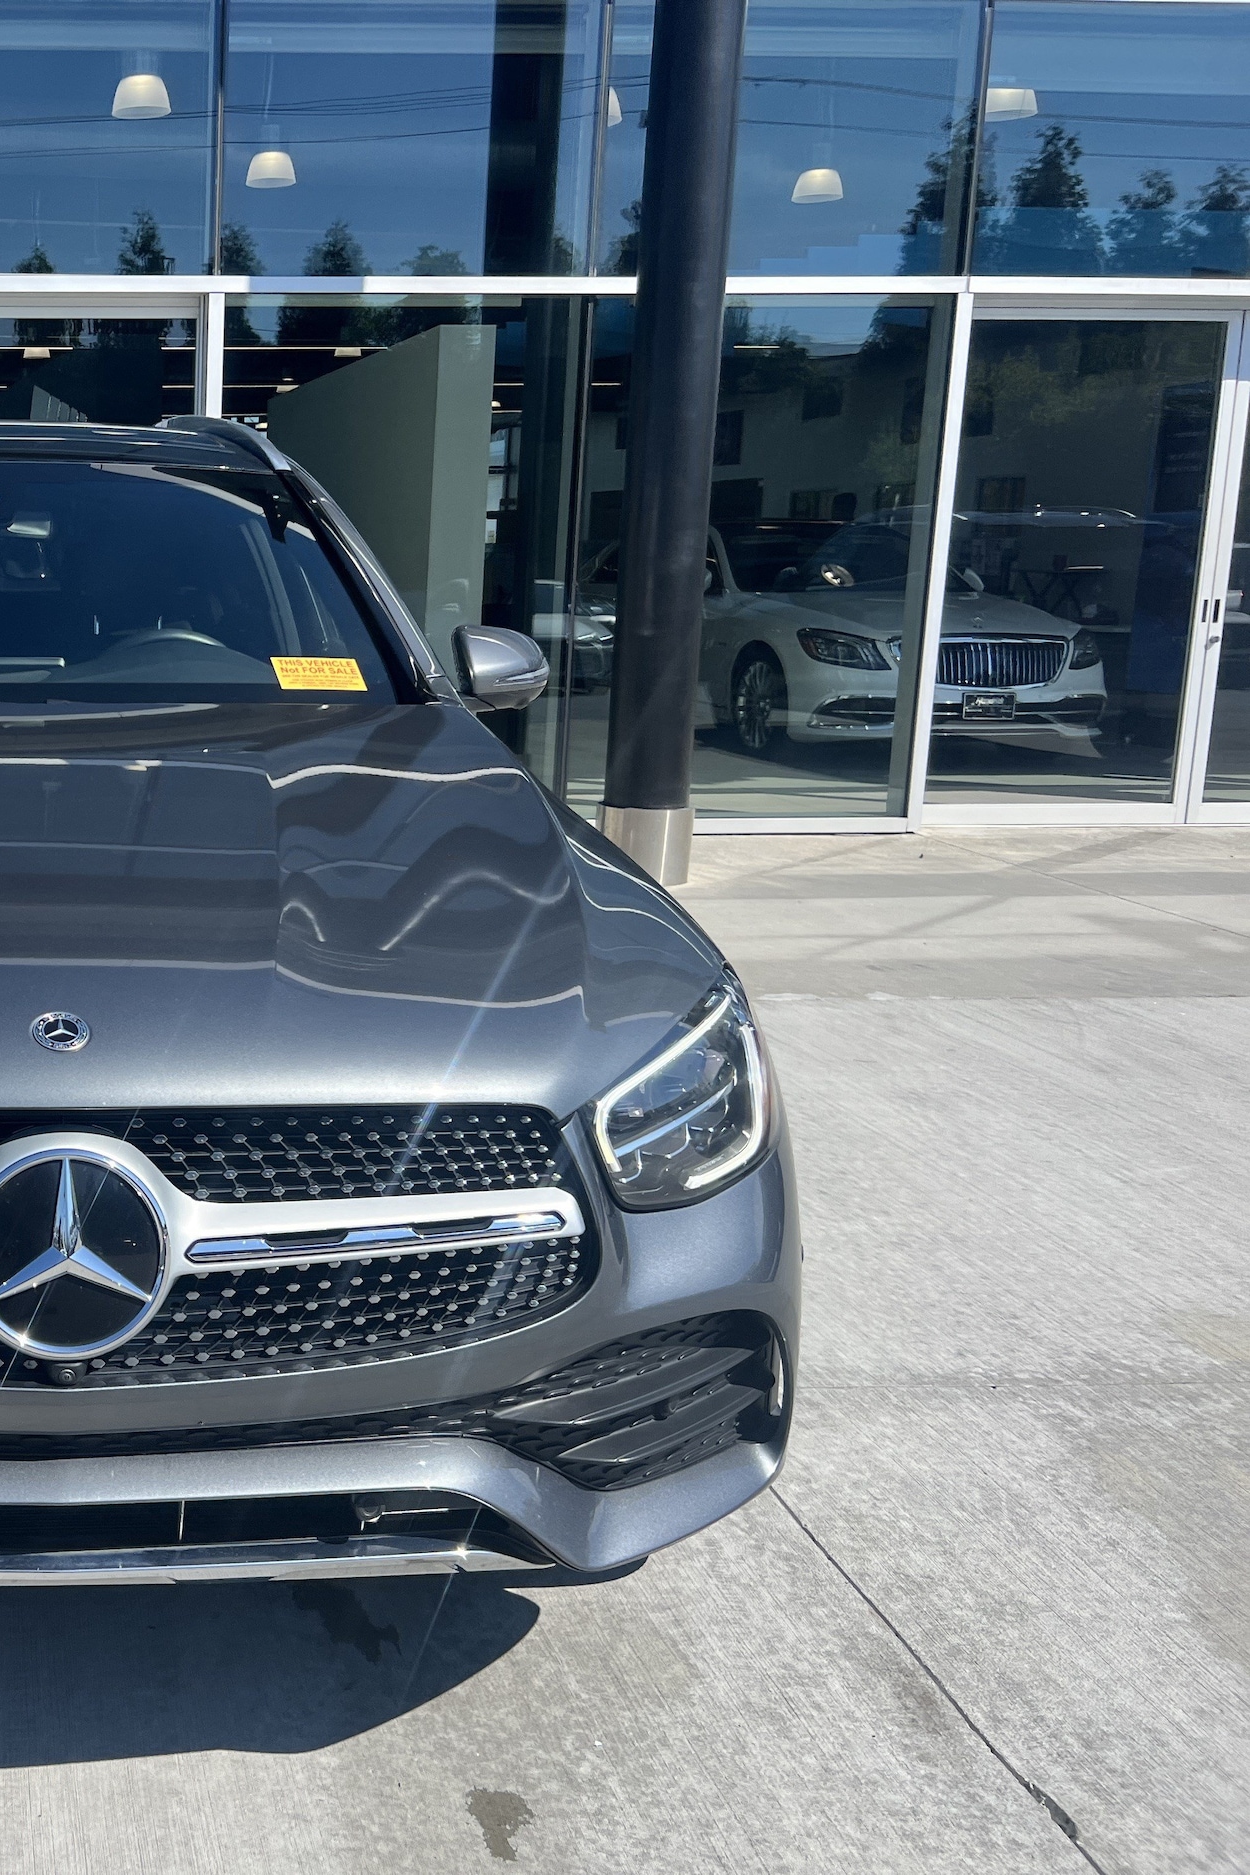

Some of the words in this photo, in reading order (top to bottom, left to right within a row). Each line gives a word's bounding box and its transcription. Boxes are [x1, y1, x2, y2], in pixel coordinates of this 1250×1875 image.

[277, 659, 304, 667] THIS
[305, 659, 353, 668] VEHICLE
[280, 666, 300, 674] Not
[302, 666, 325, 674] FOR
[328, 667, 358, 675] SALE
